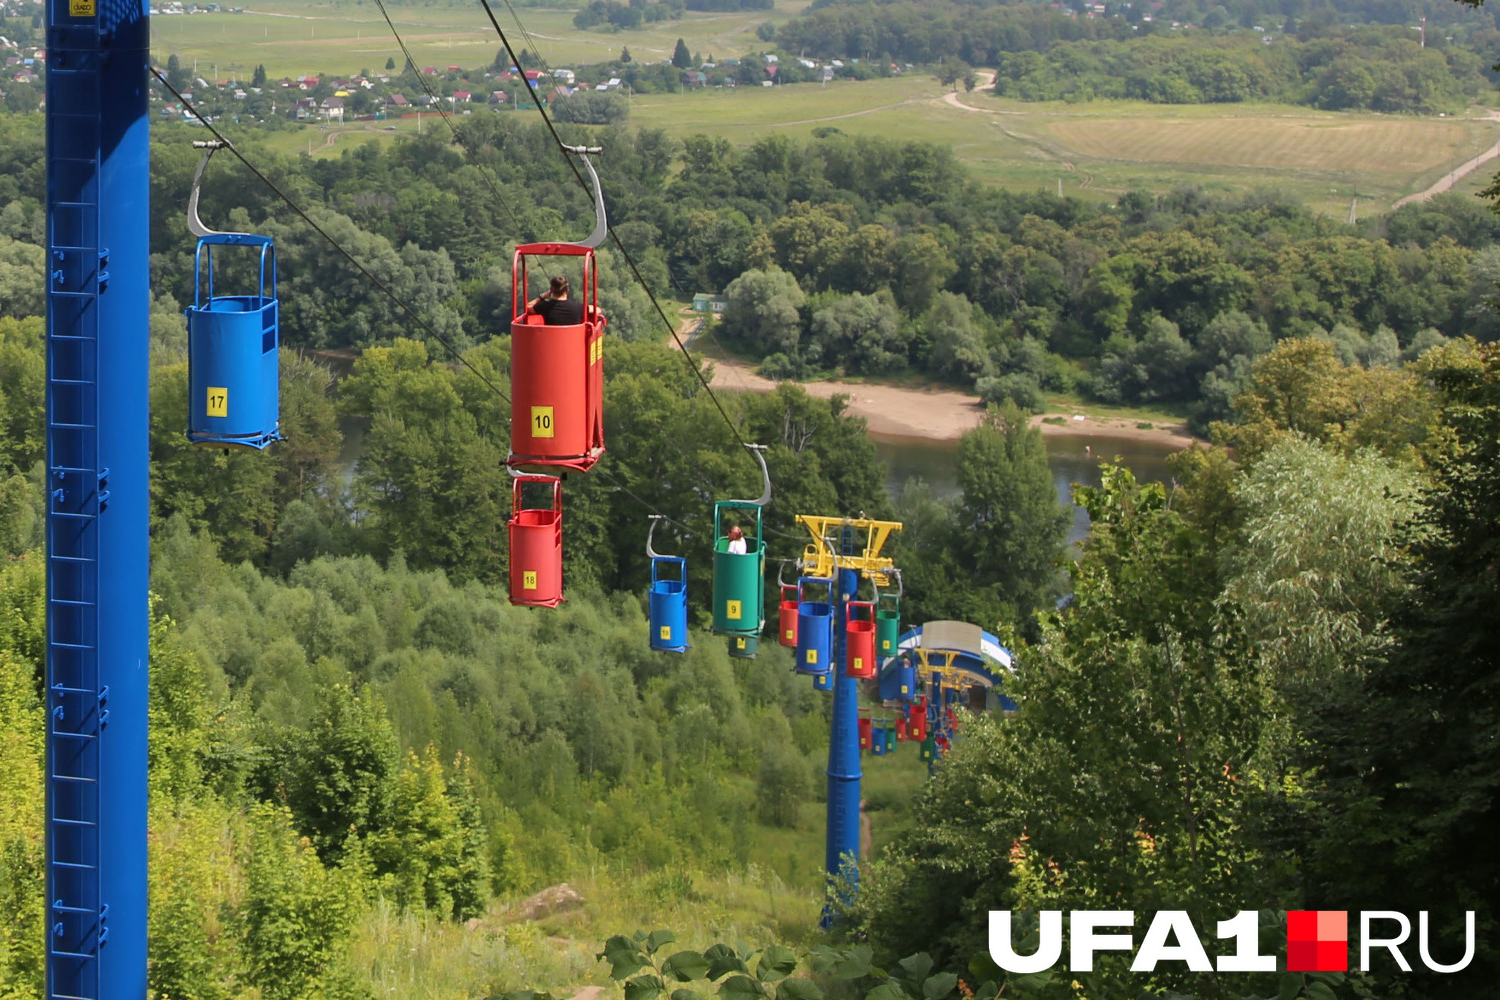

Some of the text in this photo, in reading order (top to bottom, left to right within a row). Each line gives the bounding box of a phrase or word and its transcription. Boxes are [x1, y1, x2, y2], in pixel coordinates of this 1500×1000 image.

[210, 395, 224, 408] 17
[535, 415, 550, 429] 10
[526, 576, 535, 584] 18
[731, 605, 737, 614] 9
